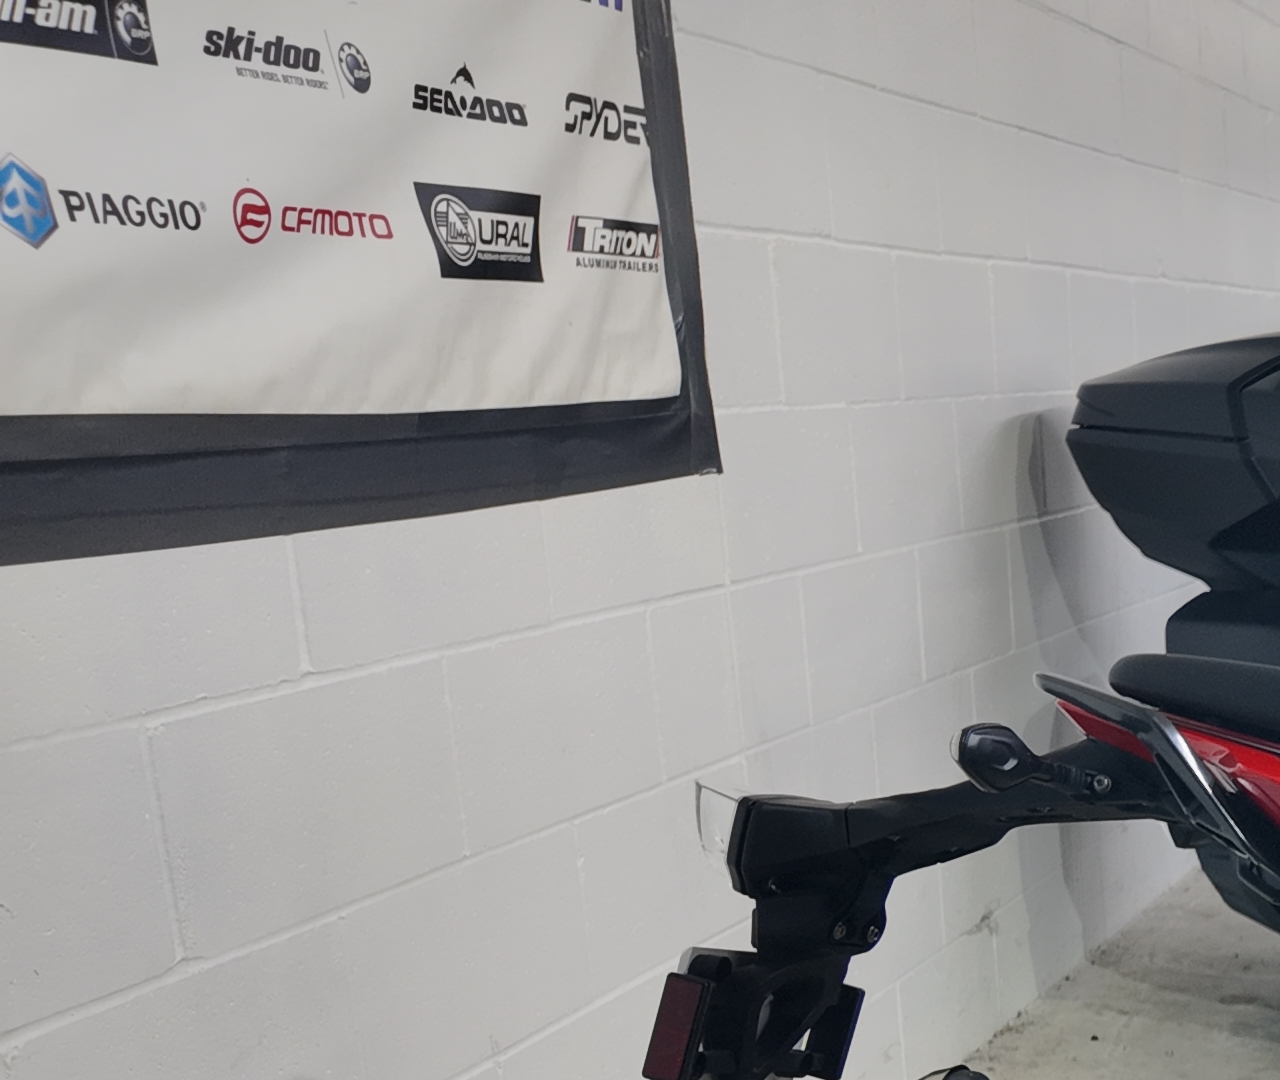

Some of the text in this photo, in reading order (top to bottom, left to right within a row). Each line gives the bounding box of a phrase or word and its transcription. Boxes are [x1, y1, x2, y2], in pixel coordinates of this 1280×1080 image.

[203, 26, 321, 73] ski-doo
[235, 66, 260, 80] BETTER
[281, 74, 305, 86] BETTER
[58, 189, 201, 231] PIAGGIO
[280, 205, 394, 240] CFMOTO
[477, 217, 530, 248] URAL
[577, 217, 657, 258] TRITON
[618, 259, 659, 274] TRAILERS
